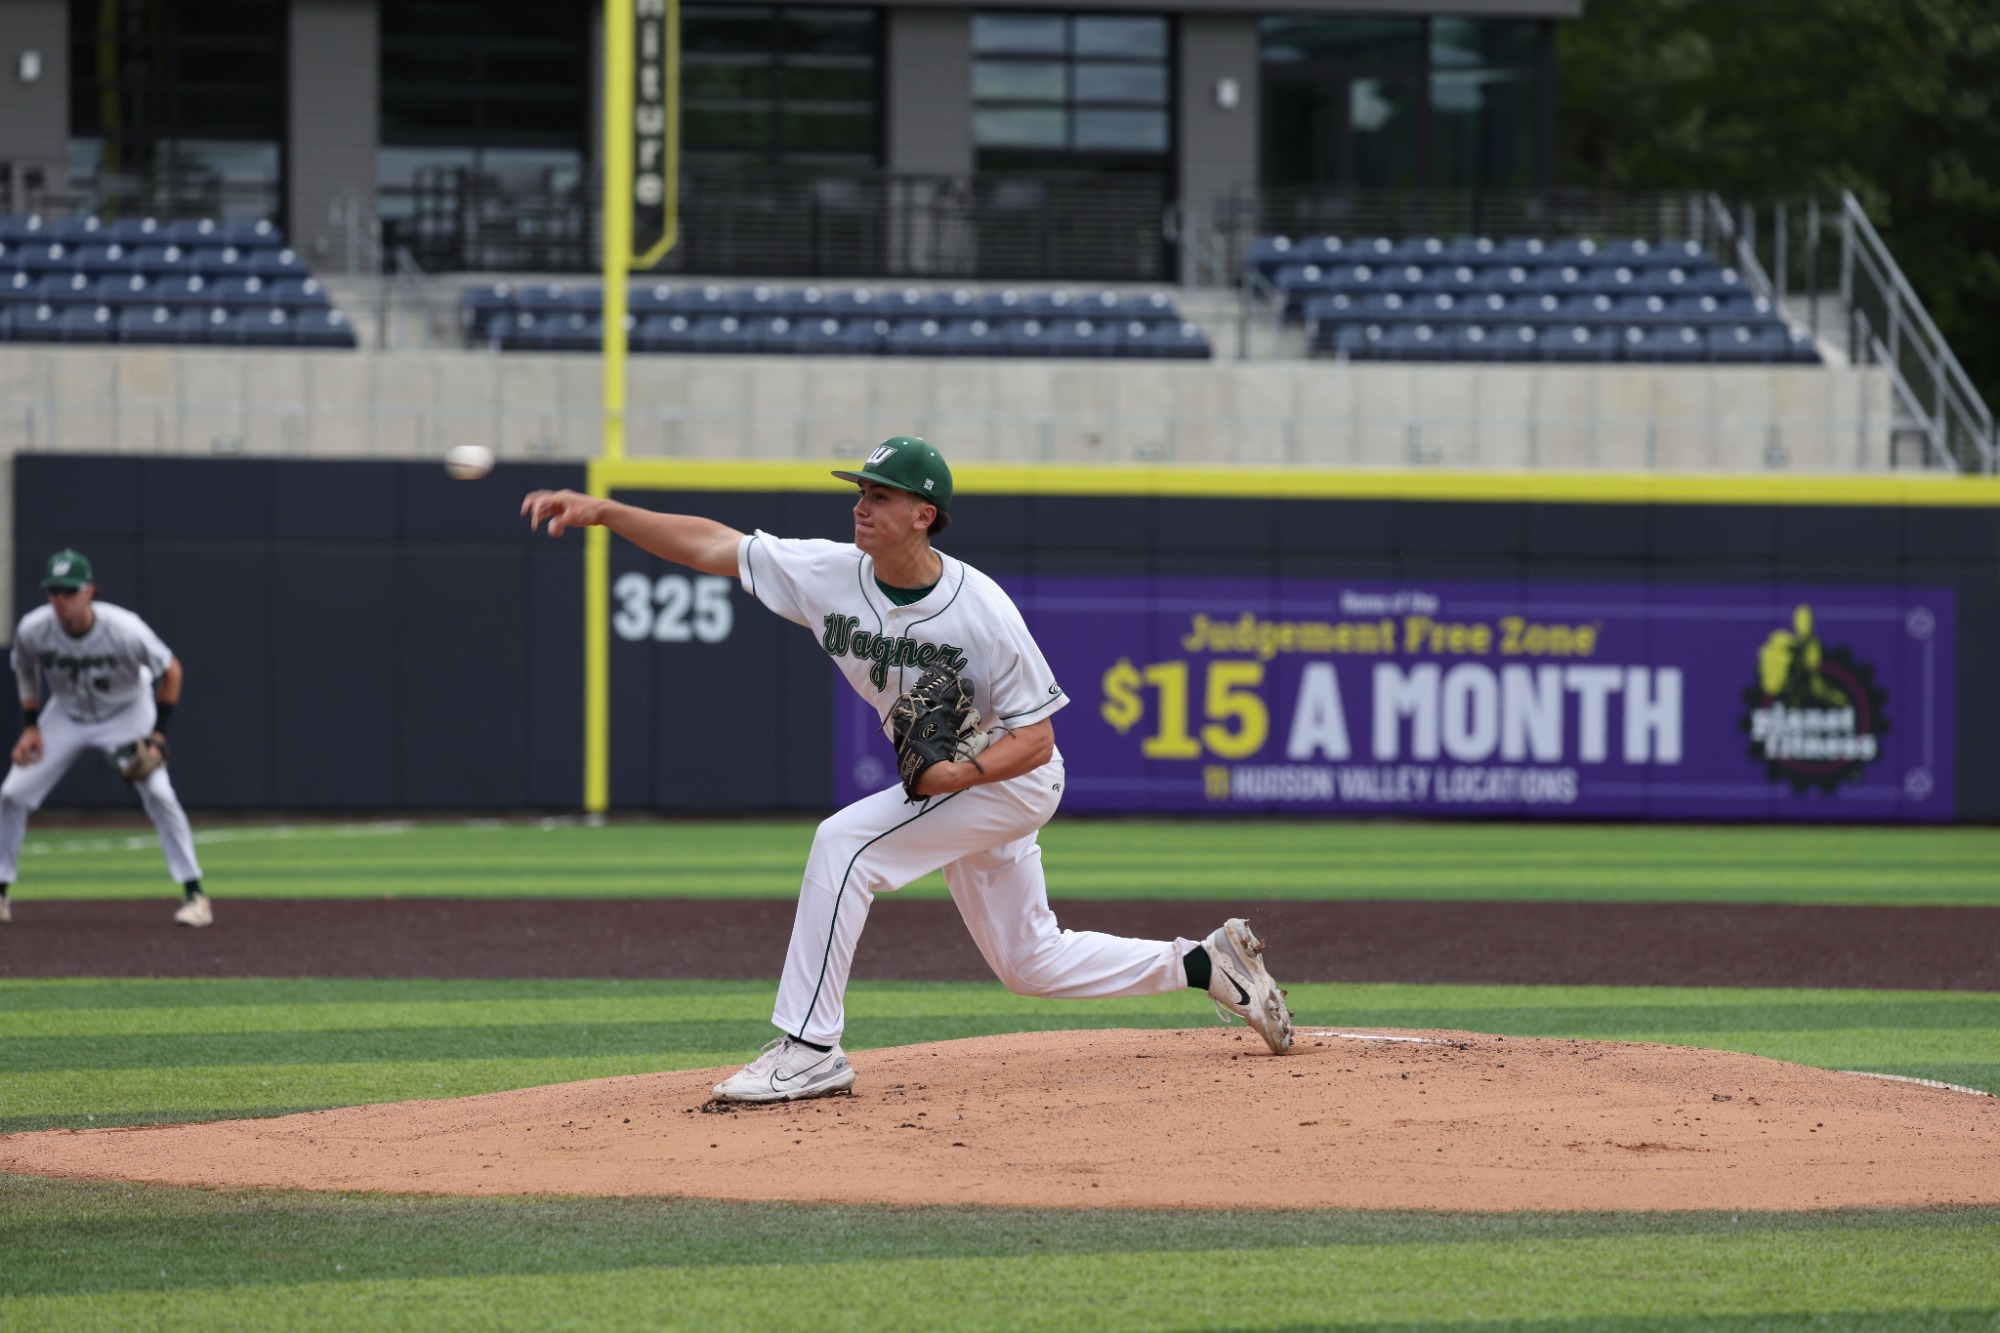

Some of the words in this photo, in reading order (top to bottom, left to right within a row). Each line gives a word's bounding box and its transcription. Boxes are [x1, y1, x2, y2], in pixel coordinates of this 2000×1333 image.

[613, 571, 734, 644] 325
[1183, 613, 1396, 660] Judgement
[1404, 616, 1491, 655] Free
[823, 613, 968, 692] Wagner
[1102, 658, 1269, 759] $15
[1286, 661, 1352, 761] A
[1372, 661, 1684, 764] MONTH
[1232, 765, 1335, 801] HUDSON
[1337, 765, 1432, 802] VALLEY
[1434, 766, 1580, 803] LOCATIONS
